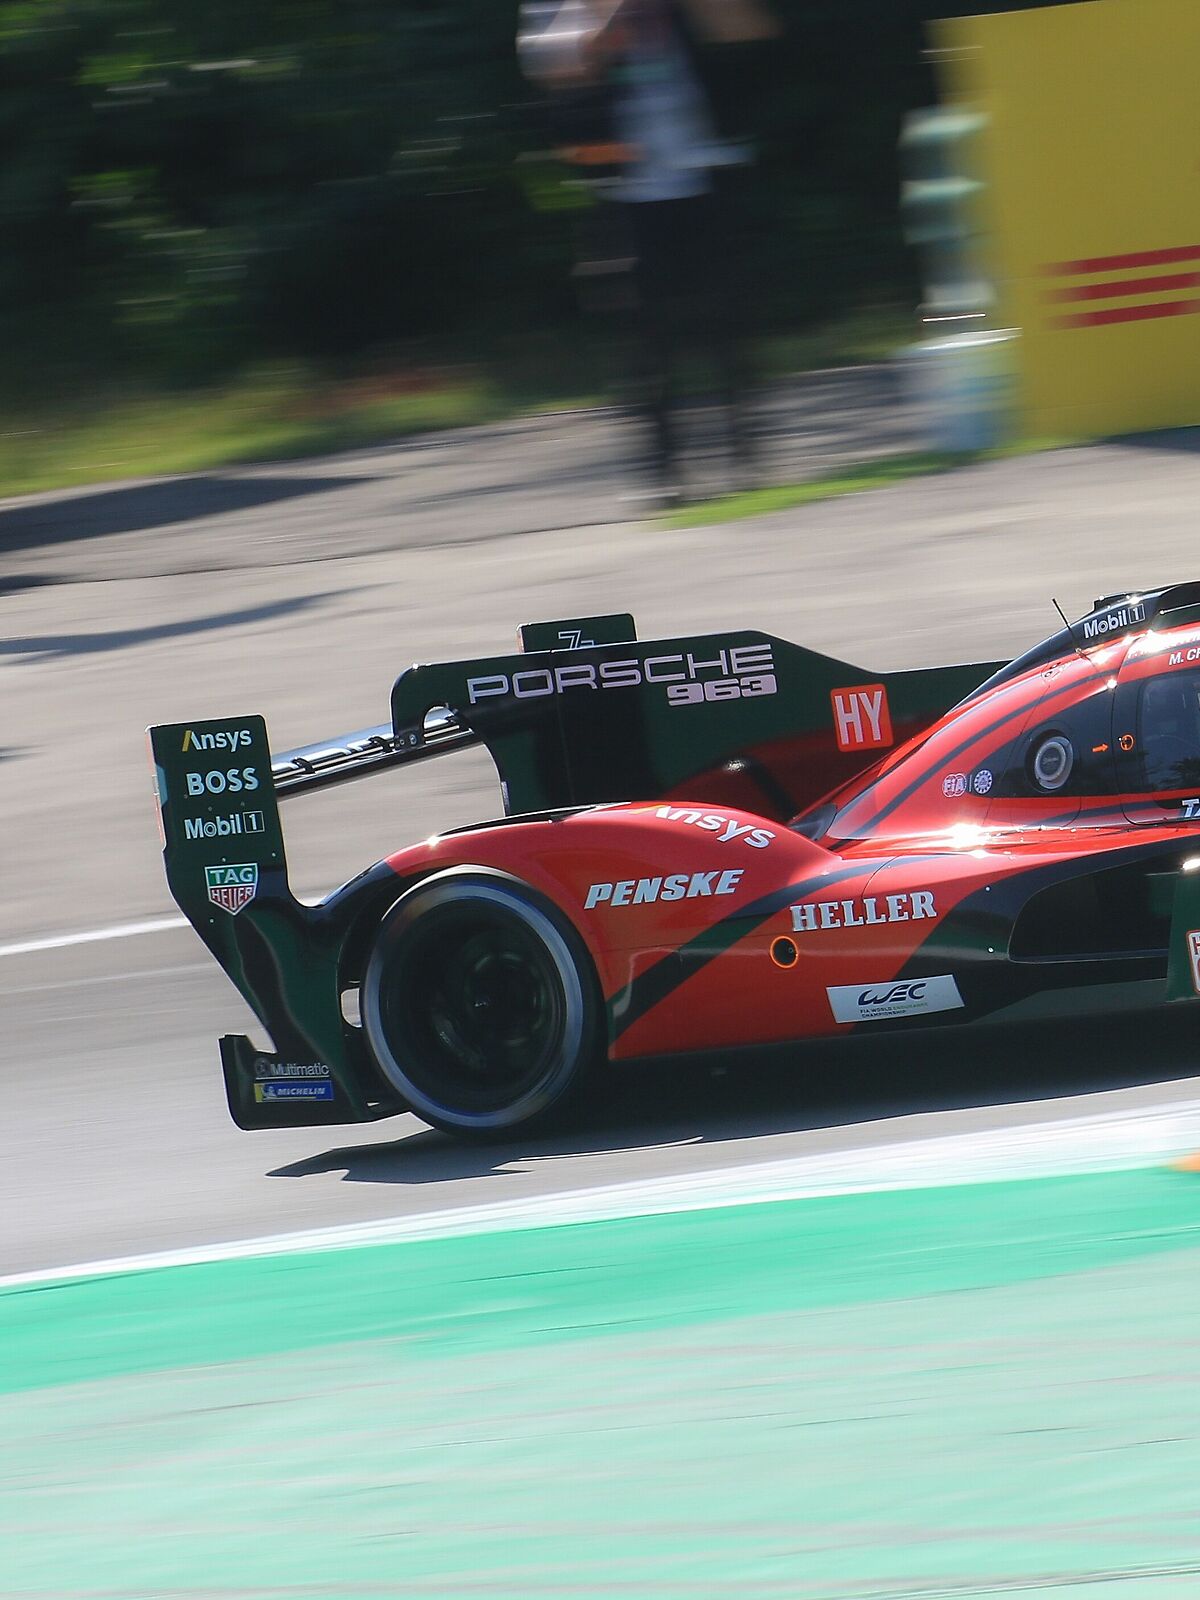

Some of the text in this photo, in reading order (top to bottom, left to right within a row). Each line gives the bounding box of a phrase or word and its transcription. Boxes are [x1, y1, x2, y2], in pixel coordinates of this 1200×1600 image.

[1084, 613, 1128, 638] Mobil
[1168, 653, 1184, 666] M.
[466, 643, 775, 704] PORSCHE
[666, 674, 778, 706] 963
[833, 690, 883, 746] HY
[181, 729, 252, 753] Ansys
[186, 767, 259, 796] BOSS
[184, 813, 242, 840] Mobil
[630, 804, 777, 849] Ansys
[209, 867, 254, 885] TAG
[584, 869, 744, 909] PENSKE
[211, 887, 255, 911] HEUER
[789, 890, 937, 932] HELLER
[858, 983, 926, 1006] WEC
[271, 1063, 330, 1076] Multimatic
[277, 1087, 326, 1095] MICHELIN
